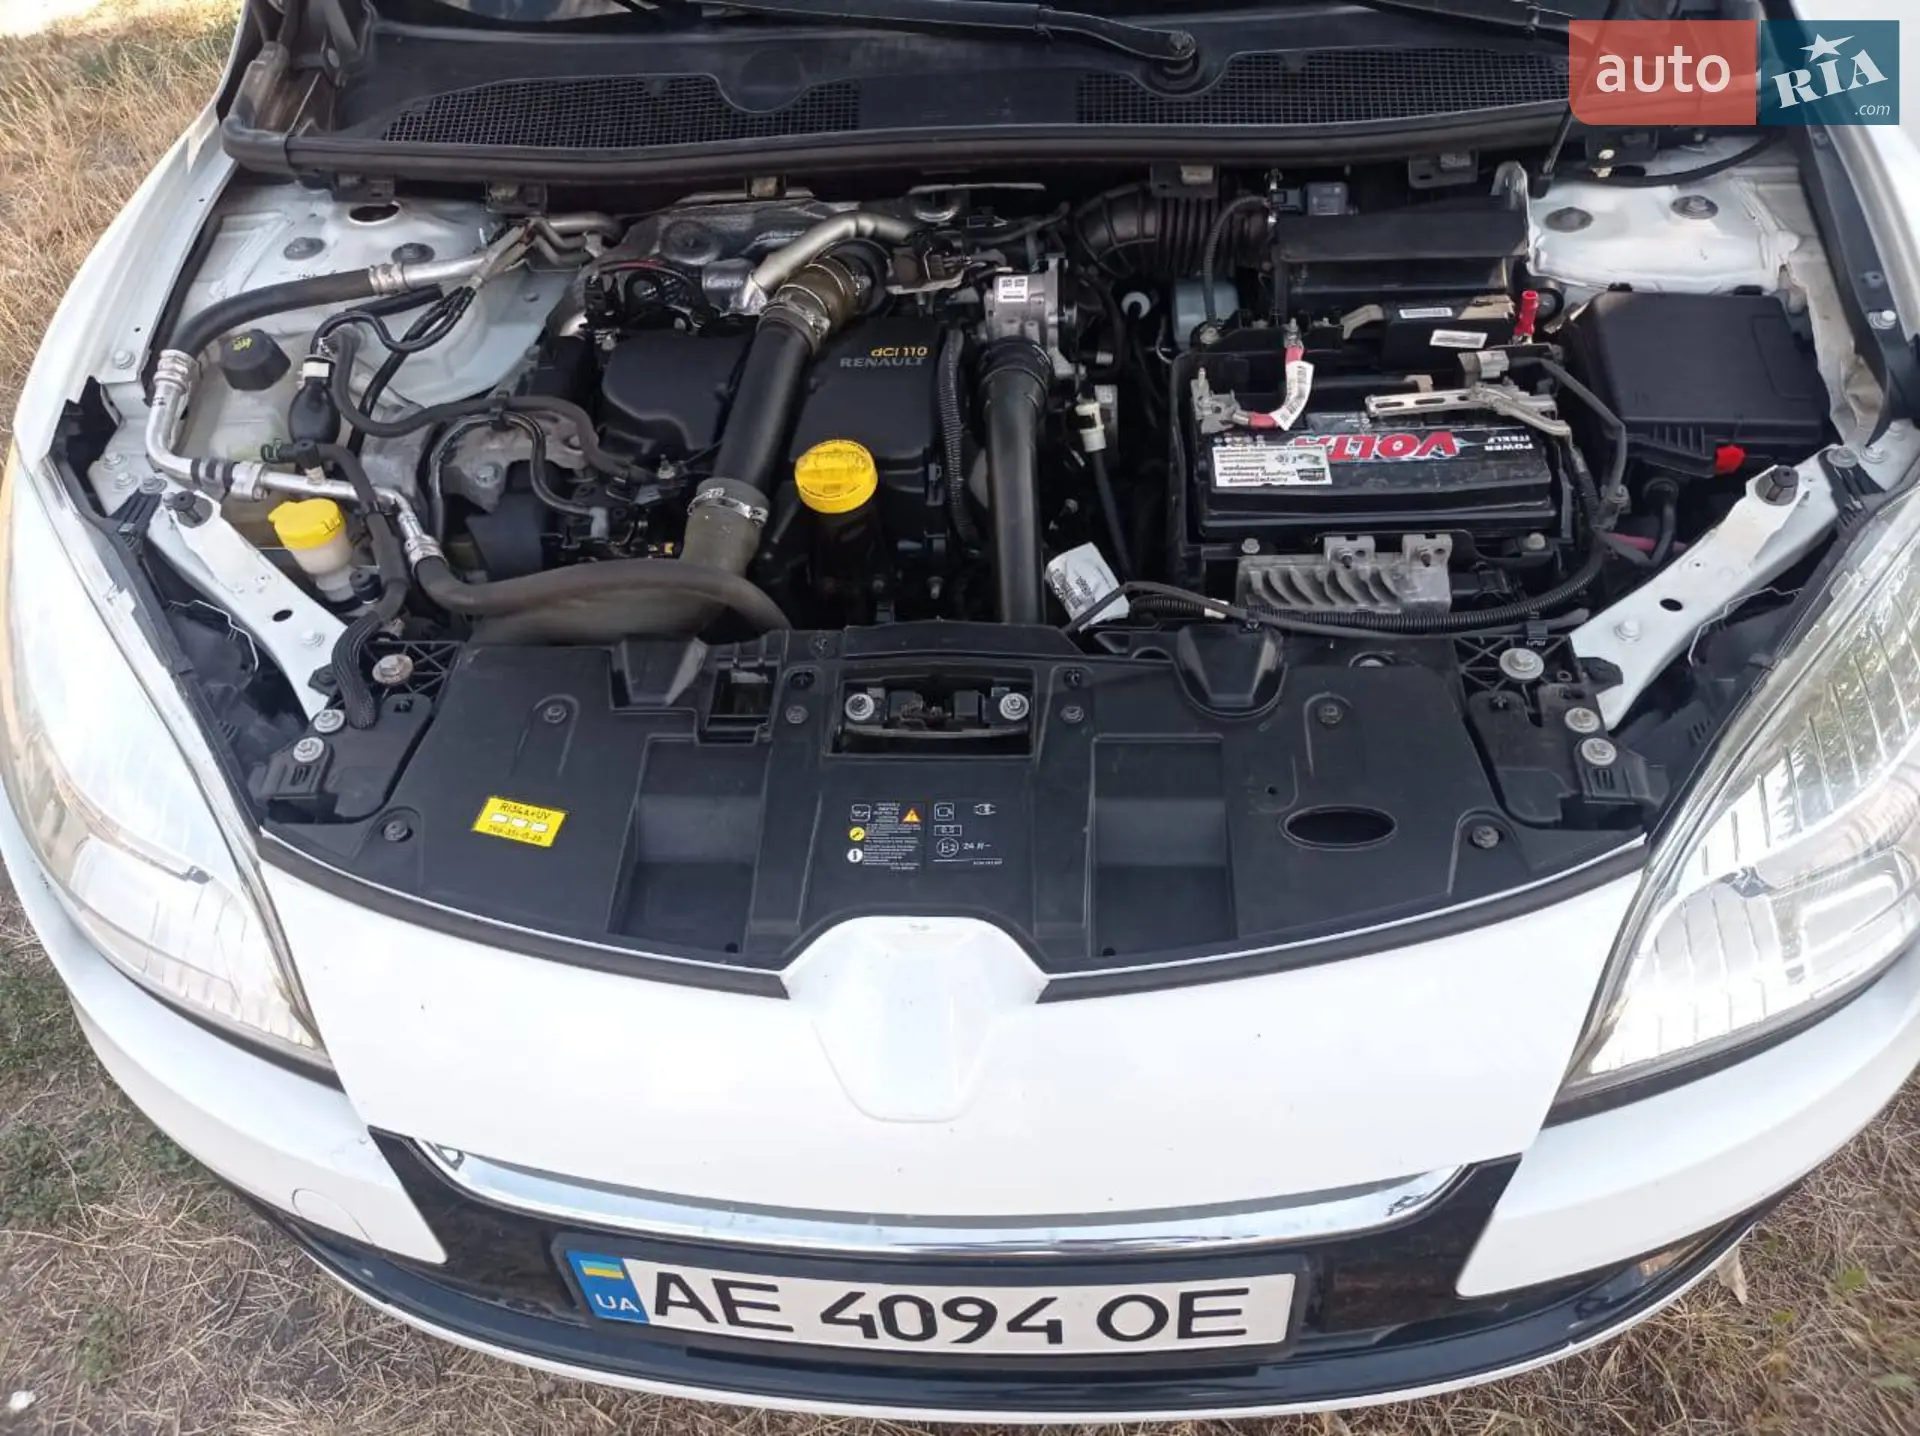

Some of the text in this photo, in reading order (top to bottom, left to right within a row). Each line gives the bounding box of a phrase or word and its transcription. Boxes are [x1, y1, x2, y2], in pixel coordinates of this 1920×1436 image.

[903, 346, 928, 357] 110
[840, 356, 924, 367] RENAULT
[1487, 434, 1531, 444] ITSELF
[1484, 442, 1534, 452] POWER
[596, 1294, 639, 1314] UA
[653, 1271, 1250, 1345] AE 4094 OE
